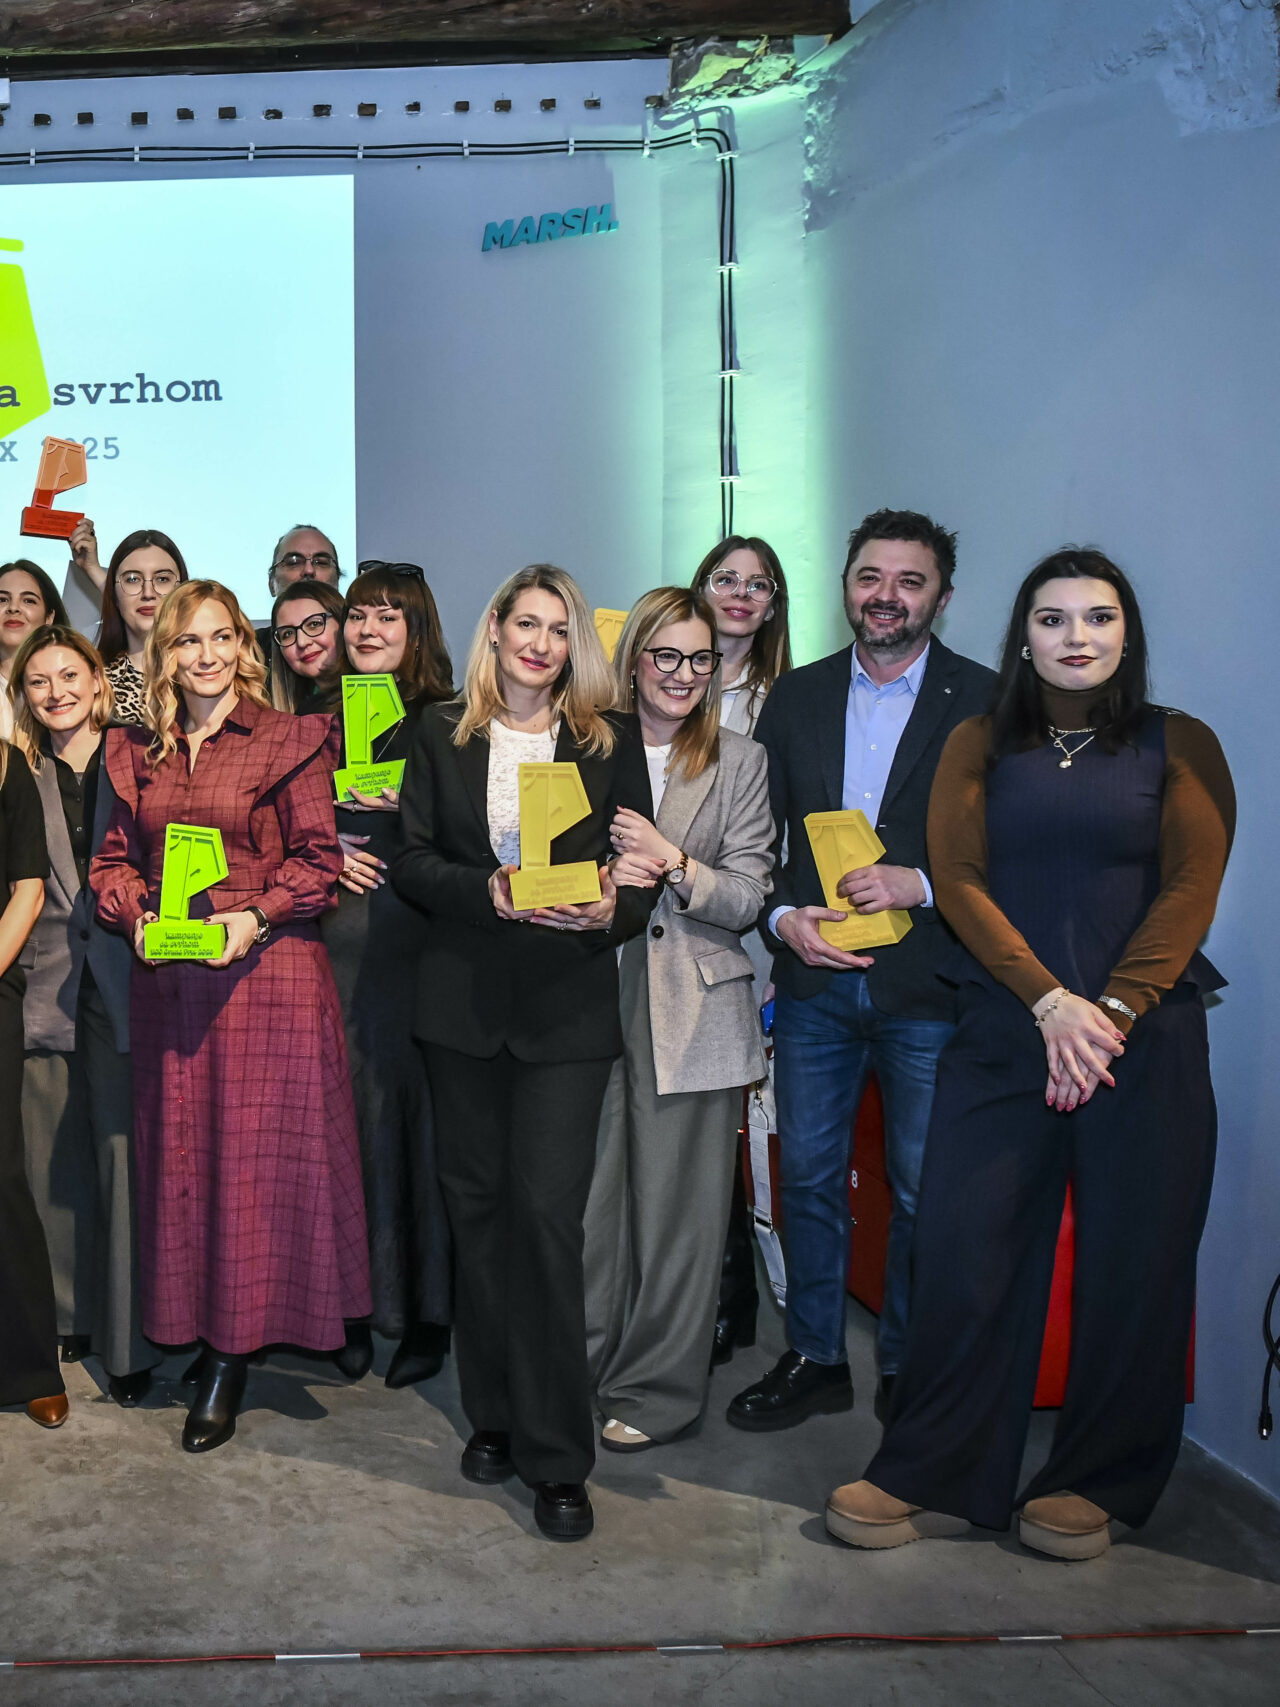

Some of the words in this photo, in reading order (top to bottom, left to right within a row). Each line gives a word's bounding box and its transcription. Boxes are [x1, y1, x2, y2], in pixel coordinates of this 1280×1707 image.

[482, 203, 619, 252] MARSH.
[53, 373, 223, 406] svrhom
[40, 437, 120, 460] 25
[852, 1170, 858, 1188] 8
